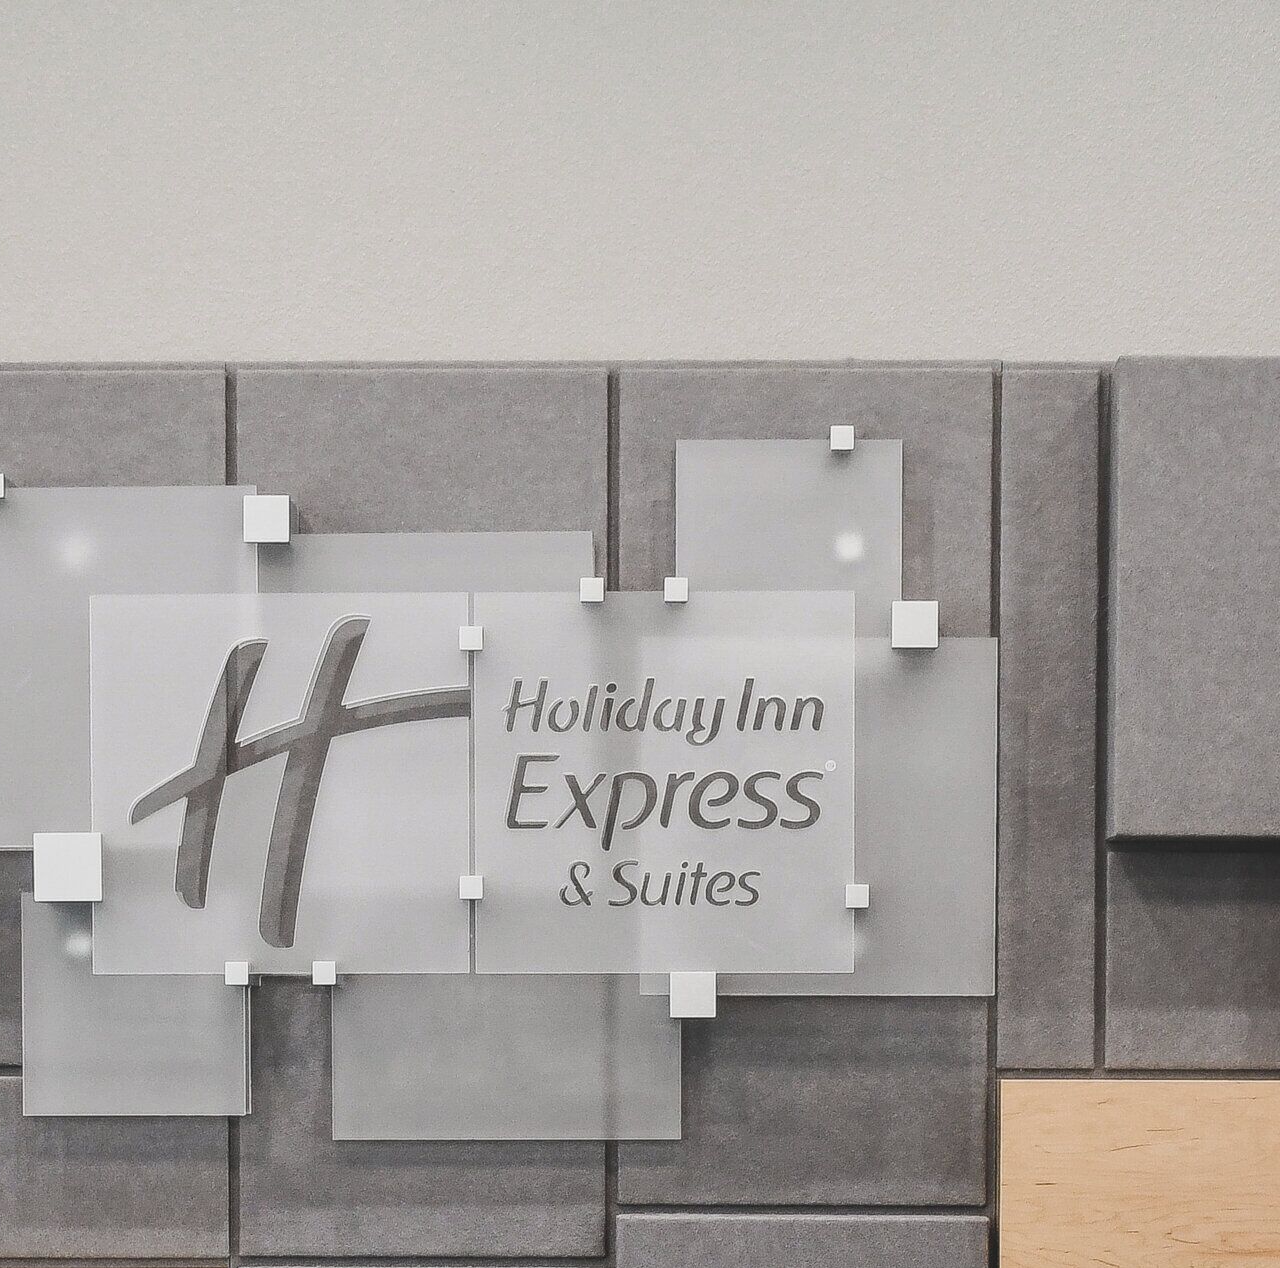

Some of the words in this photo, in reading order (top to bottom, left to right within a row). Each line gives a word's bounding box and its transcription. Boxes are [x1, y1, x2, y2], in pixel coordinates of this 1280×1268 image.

[502, 677, 726, 746] Holiday
[736, 677, 825, 731] Inn
[505, 753, 825, 851] Express
[558, 860, 594, 906] &
[608, 860, 761, 906] Suites
